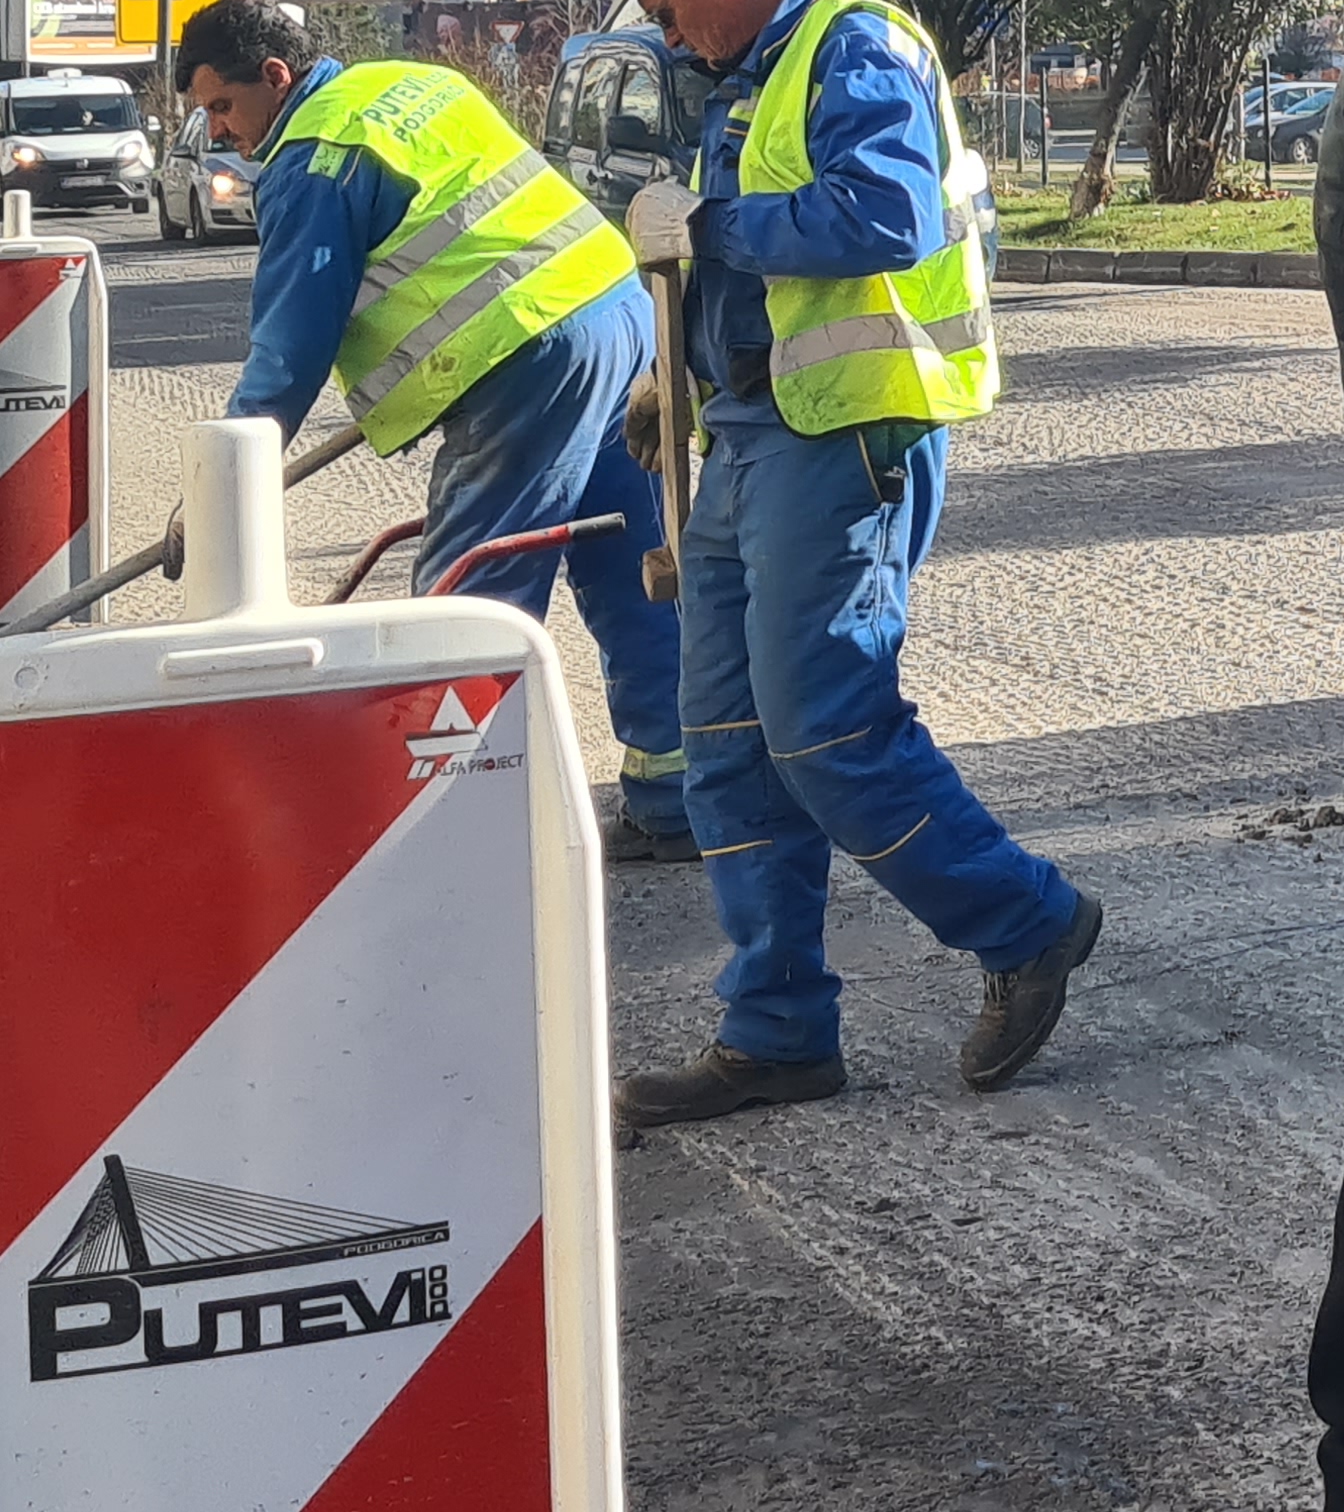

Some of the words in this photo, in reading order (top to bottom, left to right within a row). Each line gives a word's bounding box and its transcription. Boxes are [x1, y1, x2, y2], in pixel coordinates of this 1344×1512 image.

[362, 71, 431, 126] PUTEVI
[343, 1231, 446, 1257] PODGORICA
[27, 1267, 428, 1383] PUTEVI
